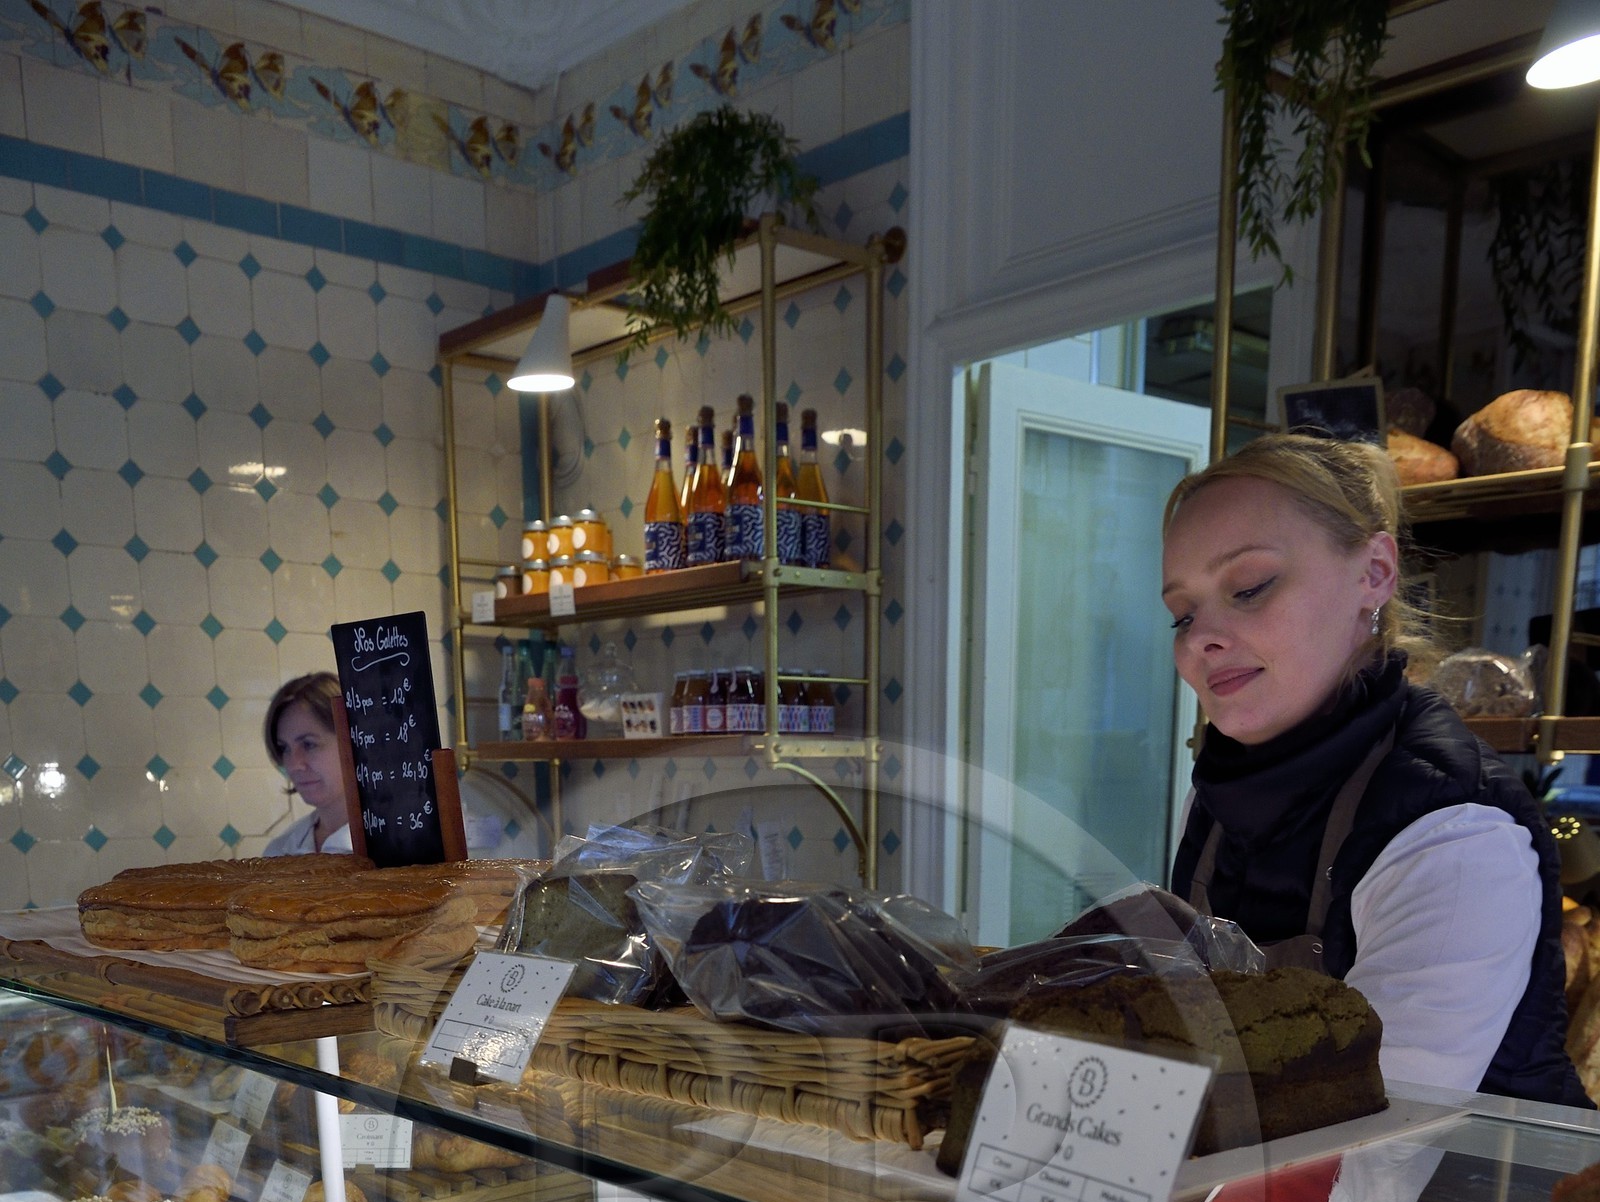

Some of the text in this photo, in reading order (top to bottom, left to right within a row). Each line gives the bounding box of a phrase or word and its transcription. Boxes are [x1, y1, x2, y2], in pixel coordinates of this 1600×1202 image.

[353, 625, 408, 652] Nos Galettes
[1027, 1102, 1124, 1147] Grands Cakes
